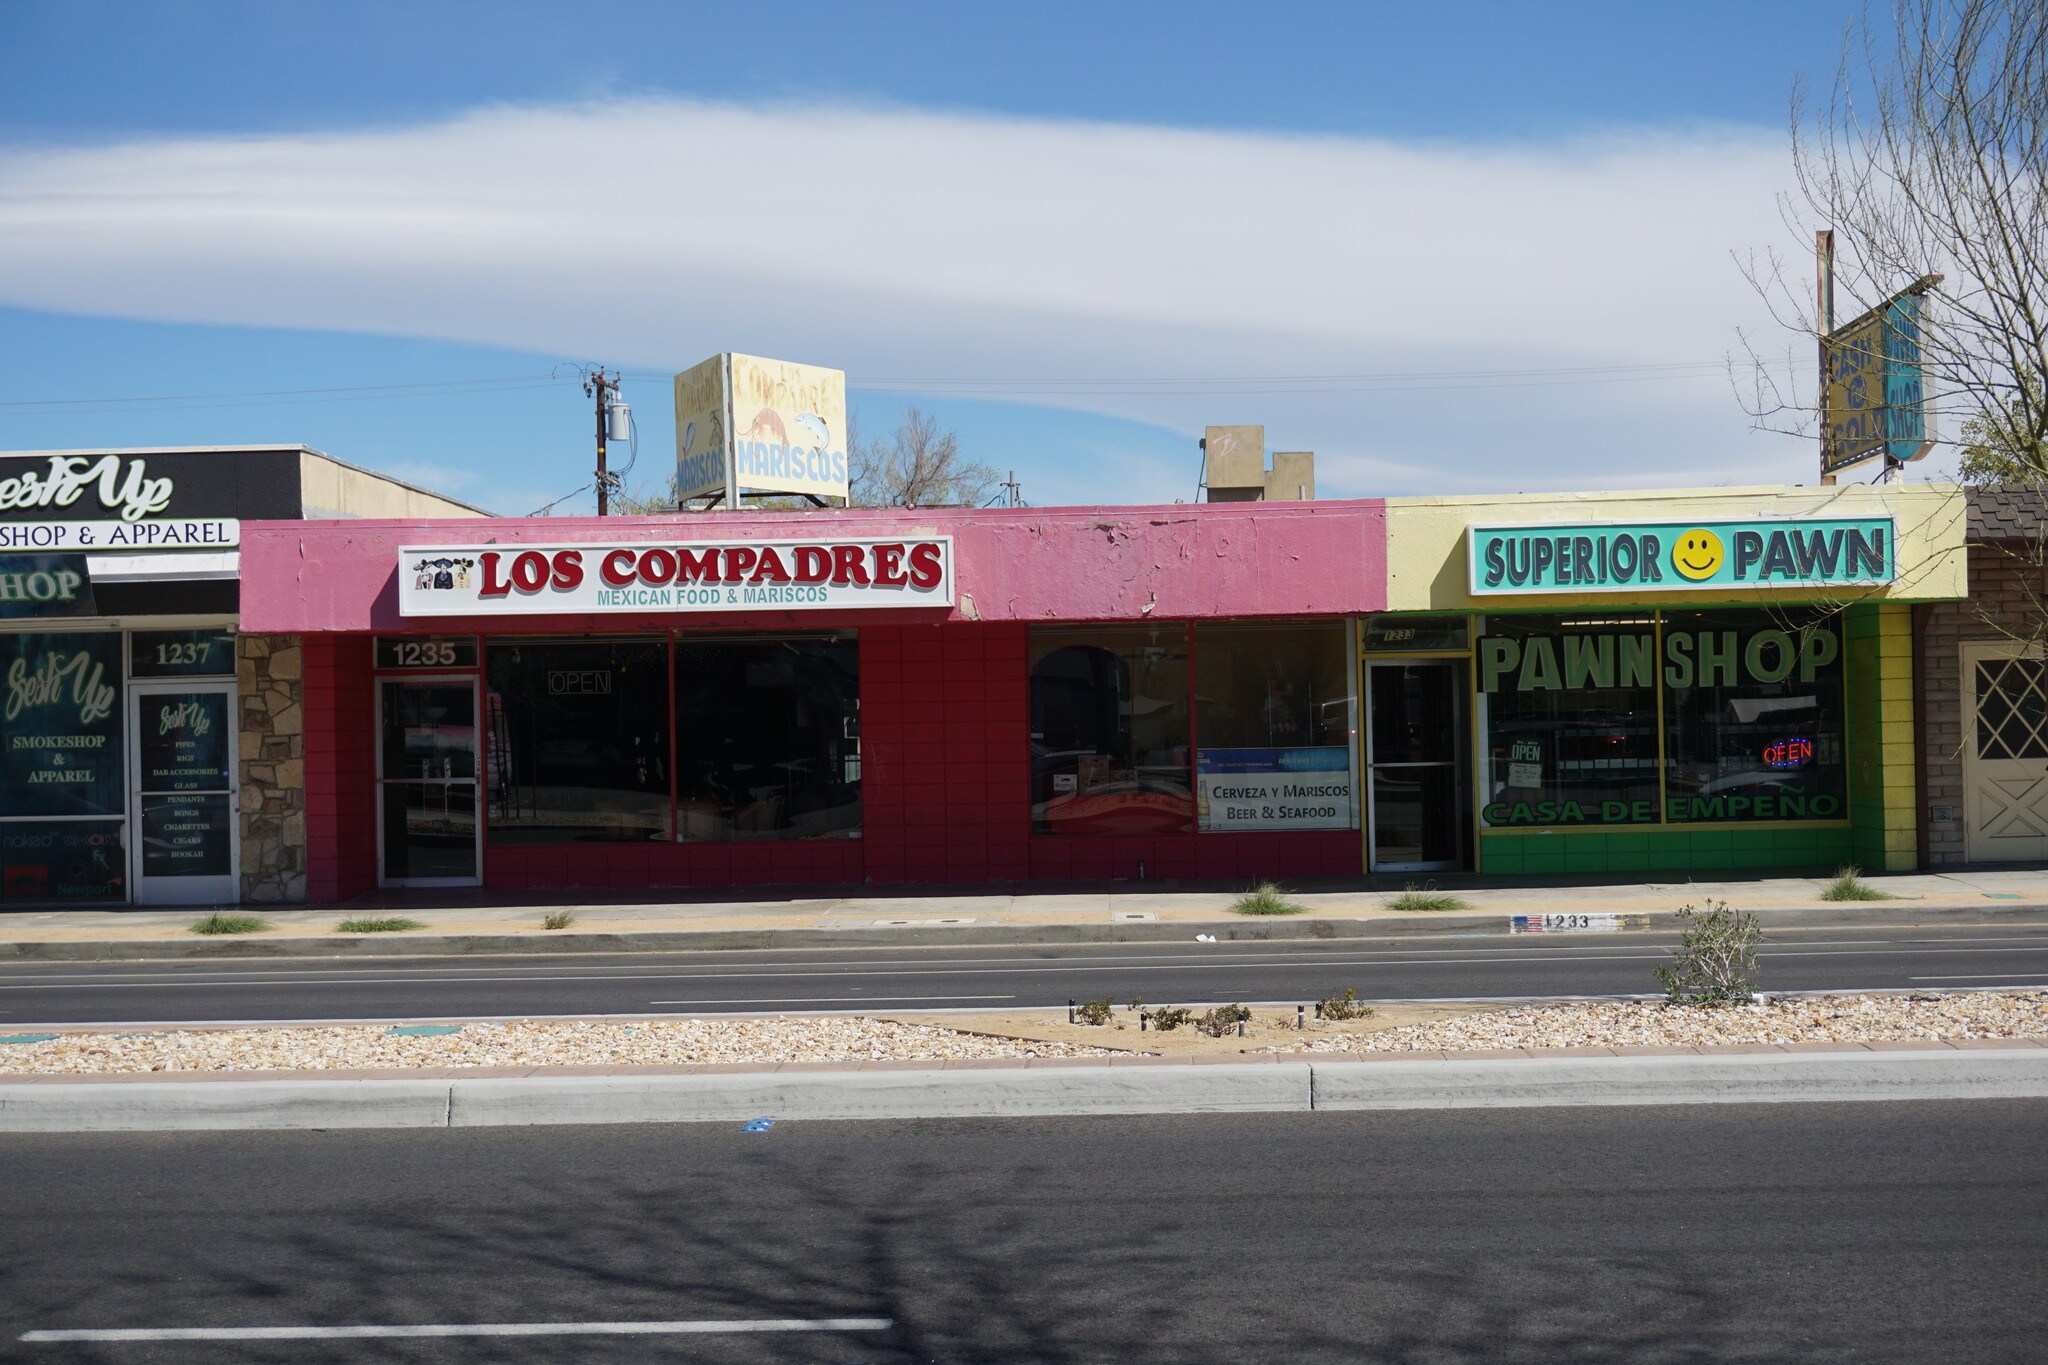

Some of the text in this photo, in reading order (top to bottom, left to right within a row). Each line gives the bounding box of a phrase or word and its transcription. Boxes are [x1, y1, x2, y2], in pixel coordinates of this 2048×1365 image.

[677, 446, 725, 493] MARISCOS
[737, 439, 846, 484] MARISCOS
[99, 455, 173, 522] Up
[79, 527, 96, 545] &
[108, 522, 231, 545] APPAREL
[1485, 528, 1885, 587] SUPERIOR PAWN
[478, 543, 943, 600] LOS COMPADRES
[0, 571, 82, 600] HOP
[597, 586, 828, 606] MEXICAN FOOD & MARISCOS
[1386, 630, 1413, 640] 1233
[156, 642, 211, 665] 1237
[393, 642, 456, 666] 1235
[551, 673, 609, 693] OPEN
[12, 735, 106, 749] SMOKESHOP
[1511, 744, 1541, 761] OPEN
[52, 752, 66, 766] &
[27, 770, 95, 783] APPAREL
[169, 768, 219, 776] ACCESSORIES
[1262, 806, 1275, 819] &
[1483, 785, 1839, 824] CASA DE EMPEÑO
[163, 823, 211, 831] CIGARETTES
[1545, 905, 1589, 929] 1233
